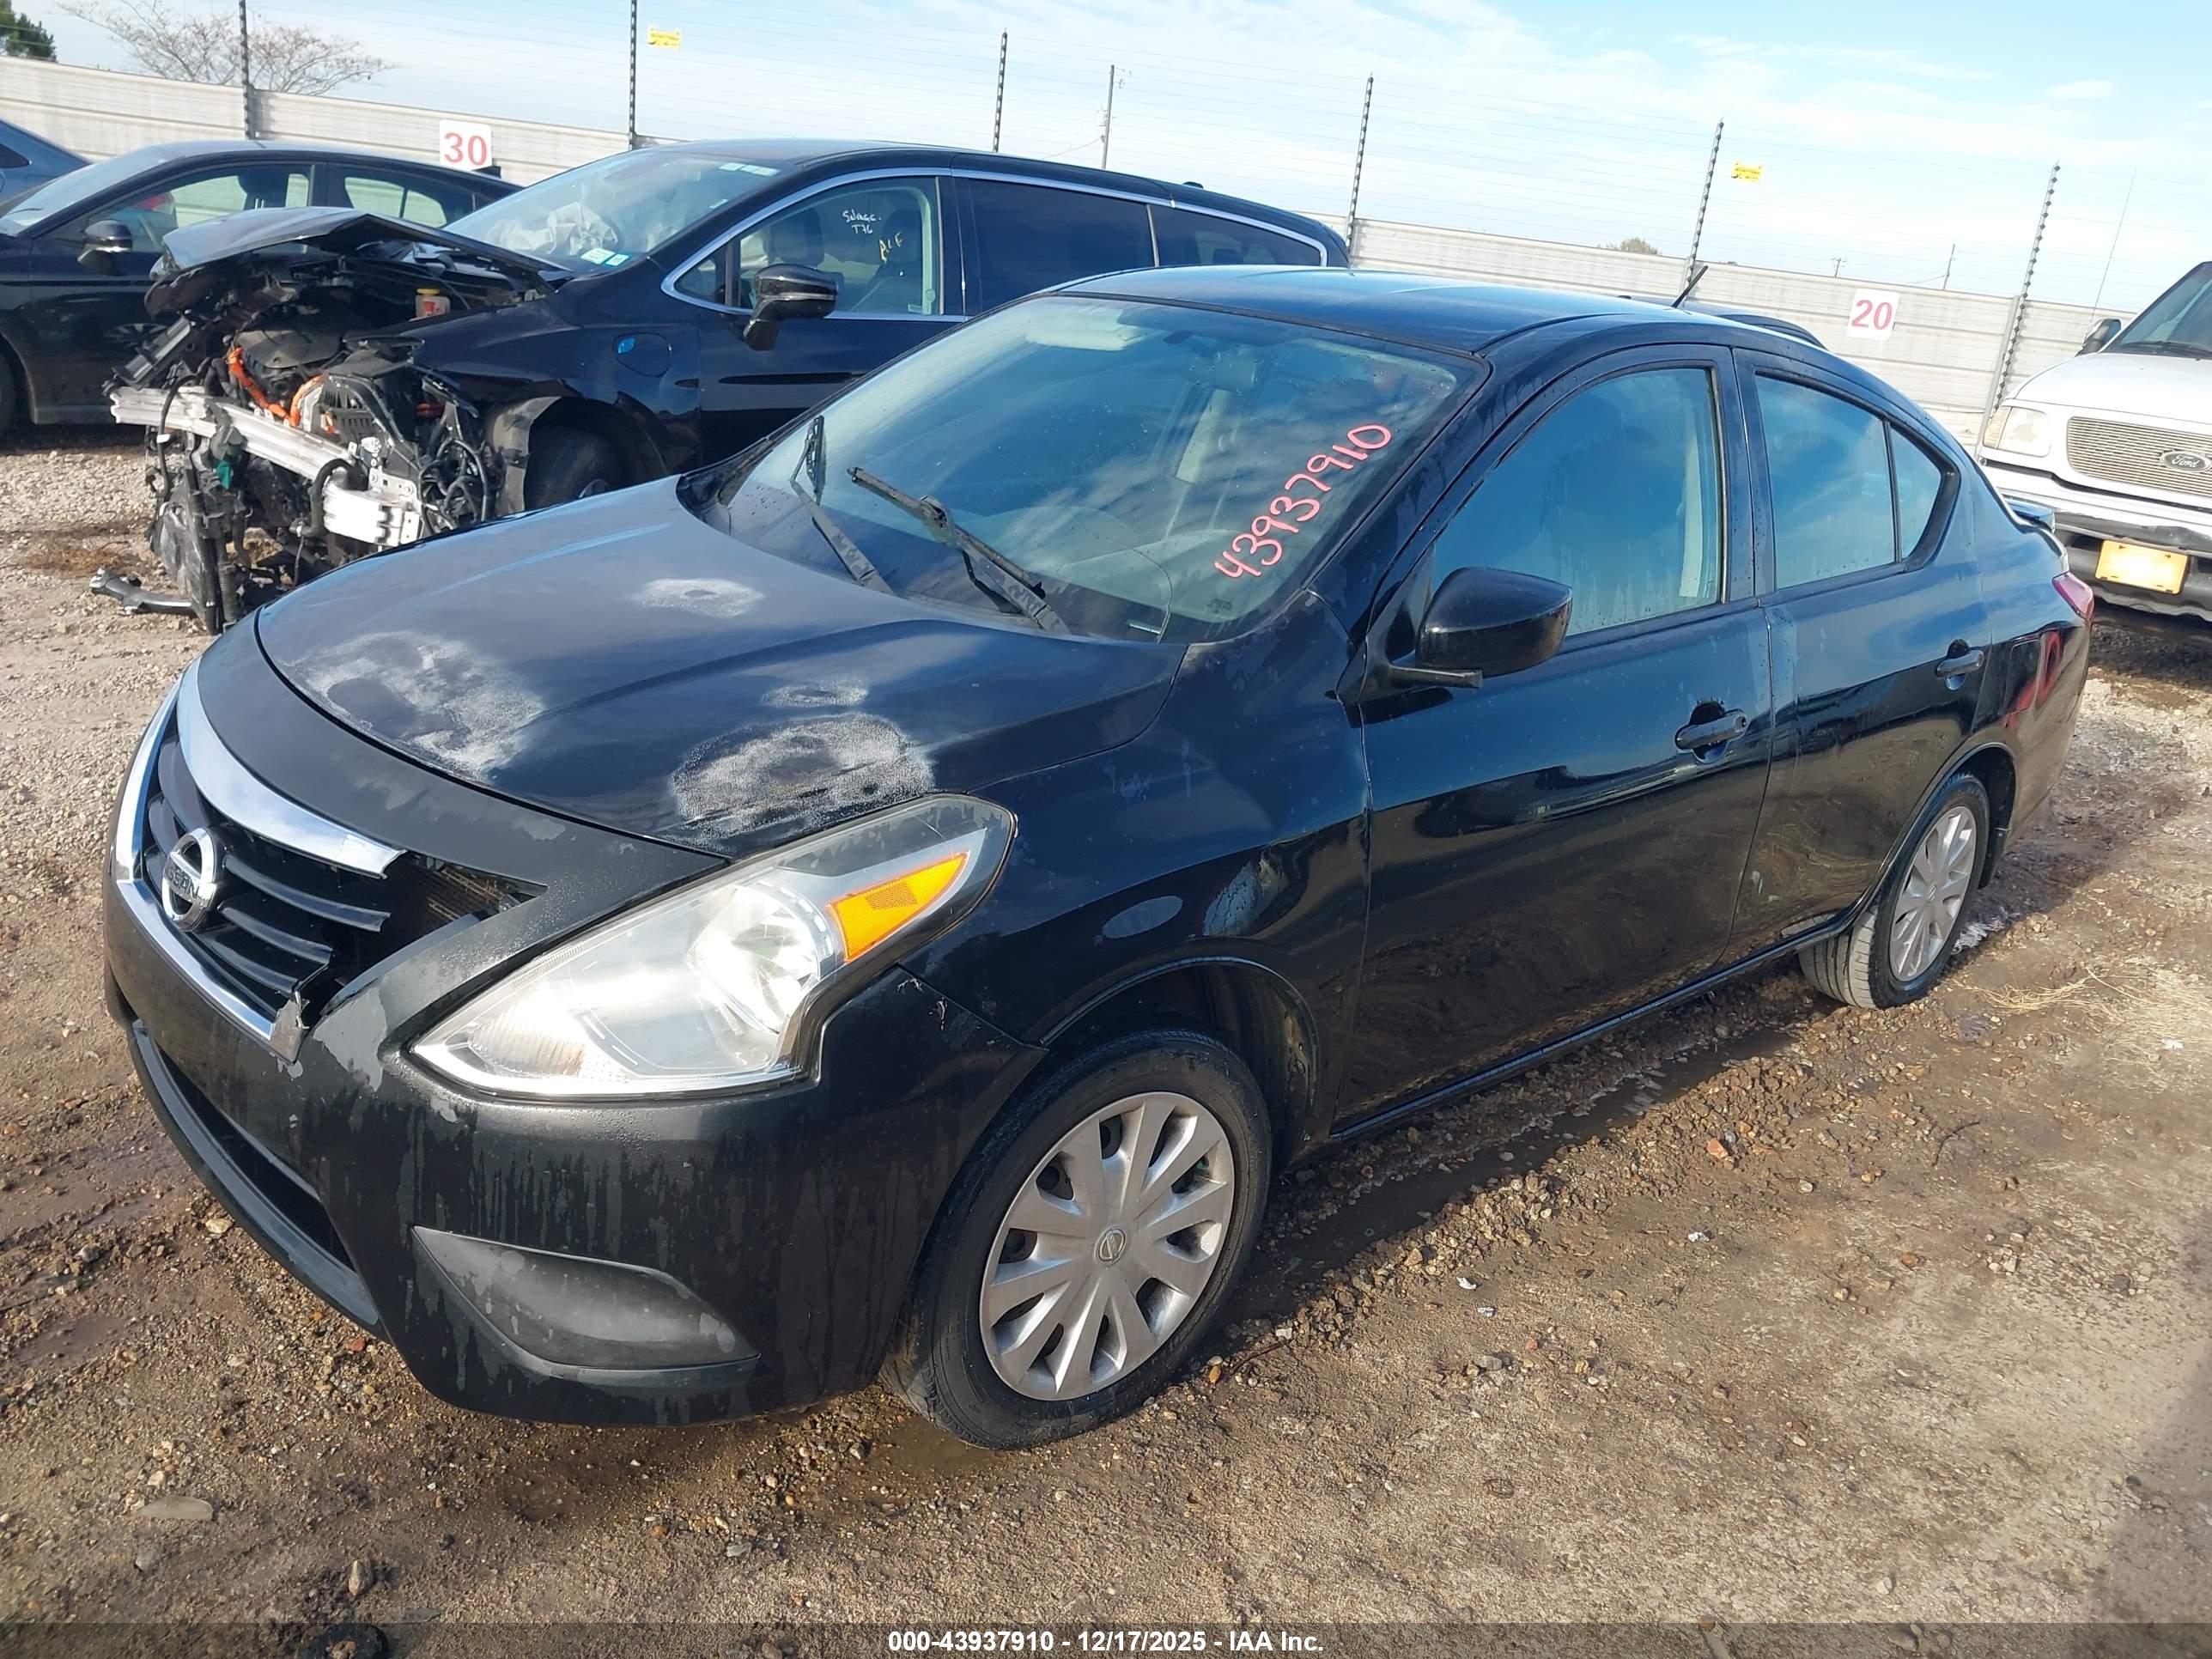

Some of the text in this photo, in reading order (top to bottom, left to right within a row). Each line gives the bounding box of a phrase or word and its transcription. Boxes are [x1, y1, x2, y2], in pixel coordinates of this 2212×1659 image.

[444, 132, 487, 166] 30
[1851, 300, 1893, 330] 20
[2172, 454, 2201, 468] Ford
[1213, 424, 1392, 578] 43937910
